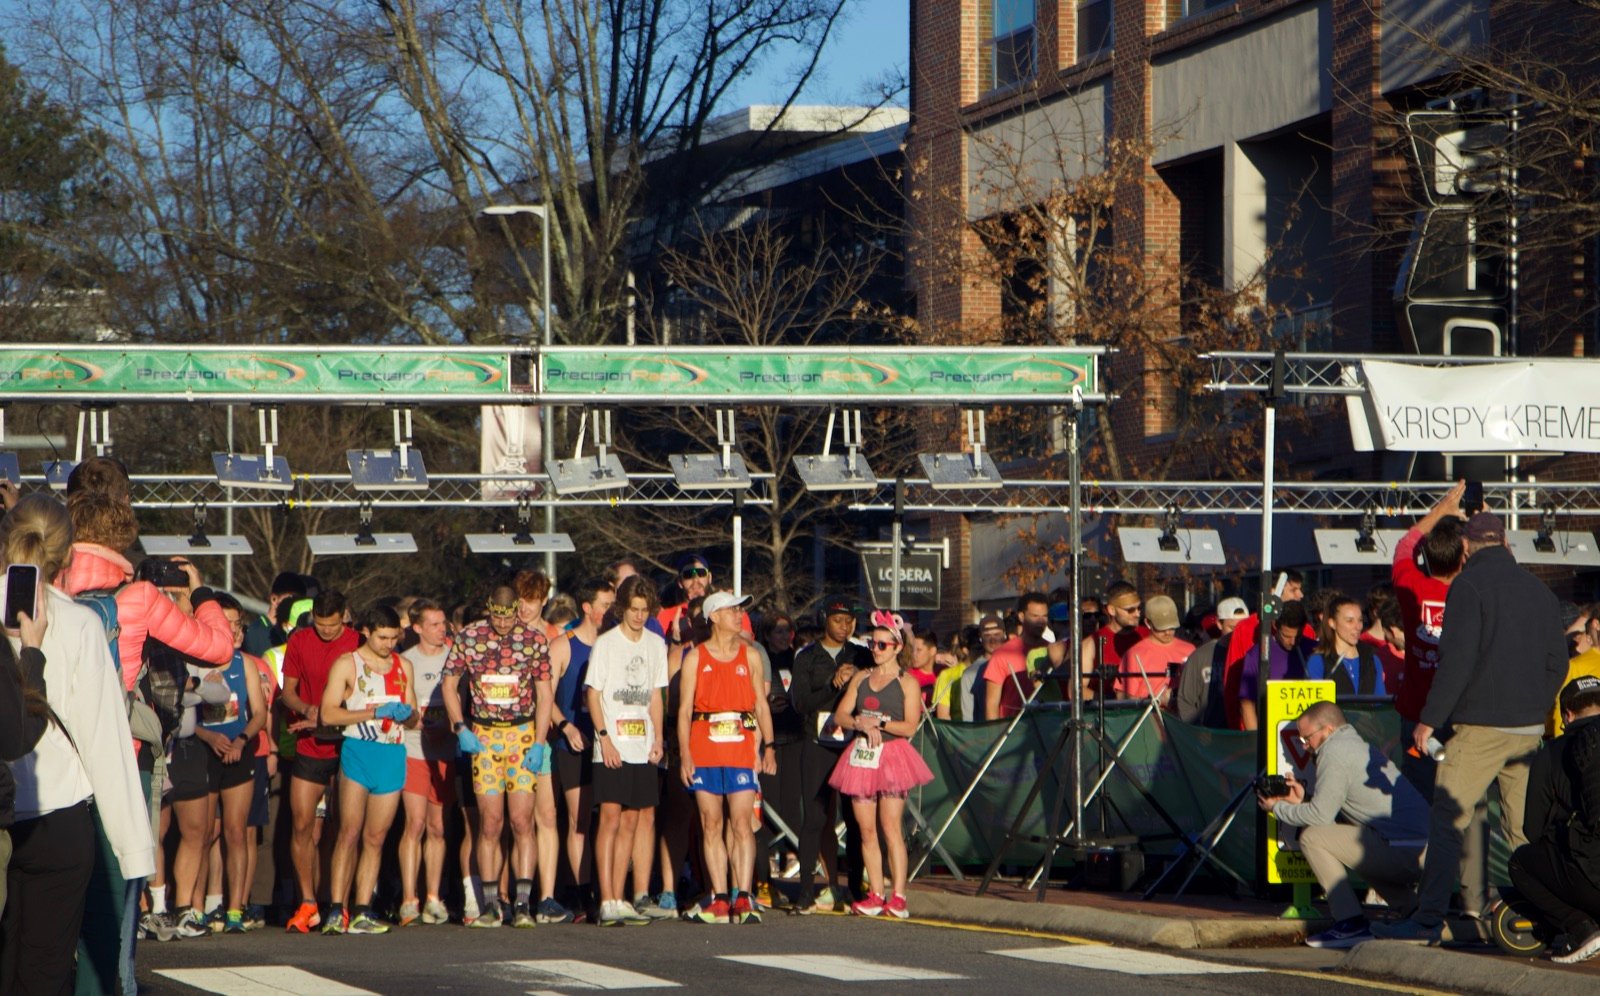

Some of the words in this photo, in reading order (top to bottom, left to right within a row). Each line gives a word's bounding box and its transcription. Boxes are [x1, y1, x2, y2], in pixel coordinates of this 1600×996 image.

[1387, 406, 1491, 439] KRISPY
[1504, 405, 1600, 440] KREME
[878, 567, 933, 582] LOBERA
[1280, 687, 1324, 700] STATE
[624, 723, 645, 736] 1572
[854, 748, 875, 761] 7029
